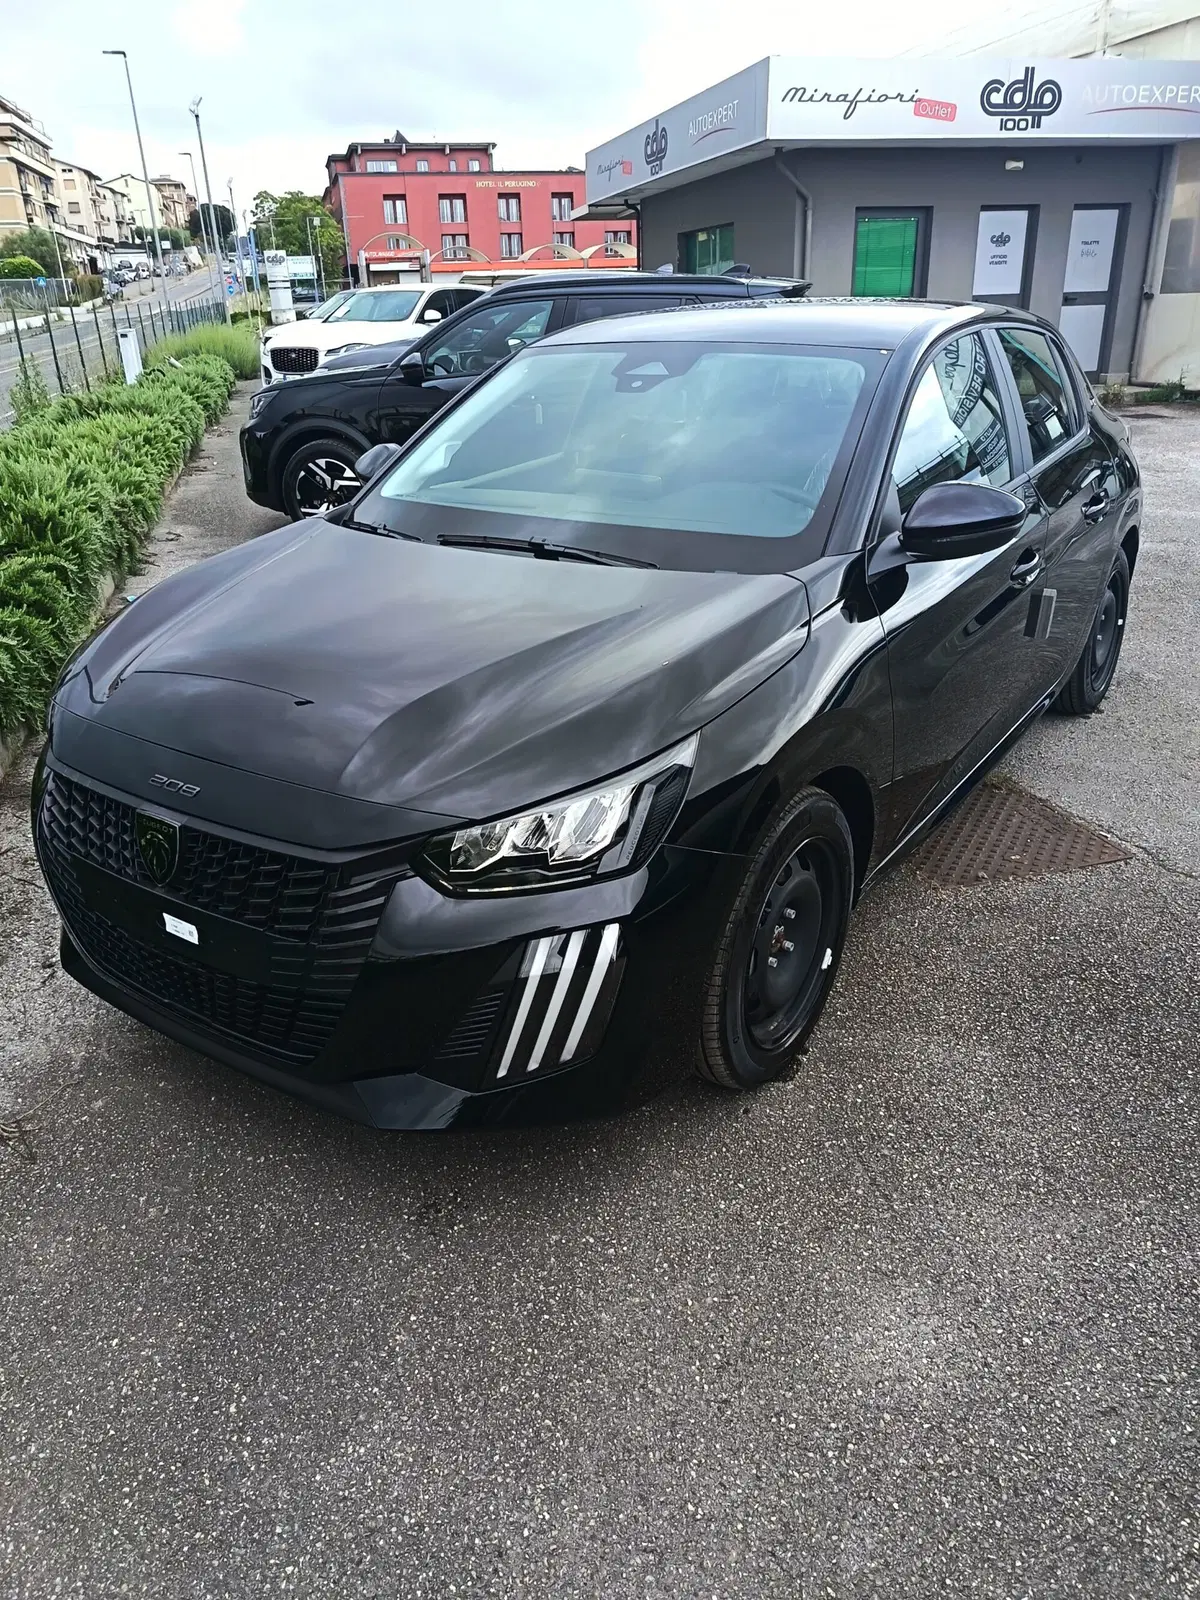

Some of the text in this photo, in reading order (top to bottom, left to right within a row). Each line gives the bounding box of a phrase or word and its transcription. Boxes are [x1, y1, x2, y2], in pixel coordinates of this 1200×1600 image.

[781, 86, 919, 120] Mirafiori
[919, 102, 952, 118] Outlet
[688, 99, 739, 138] AUTOEXPERT
[999, 117, 1030, 131] 100
[475, 180, 497, 188] HOTEL
[504, 180, 537, 188] PERUGINO
[148, 773, 201, 797] 208
[626, 826, 641, 861] PEUGEOT
